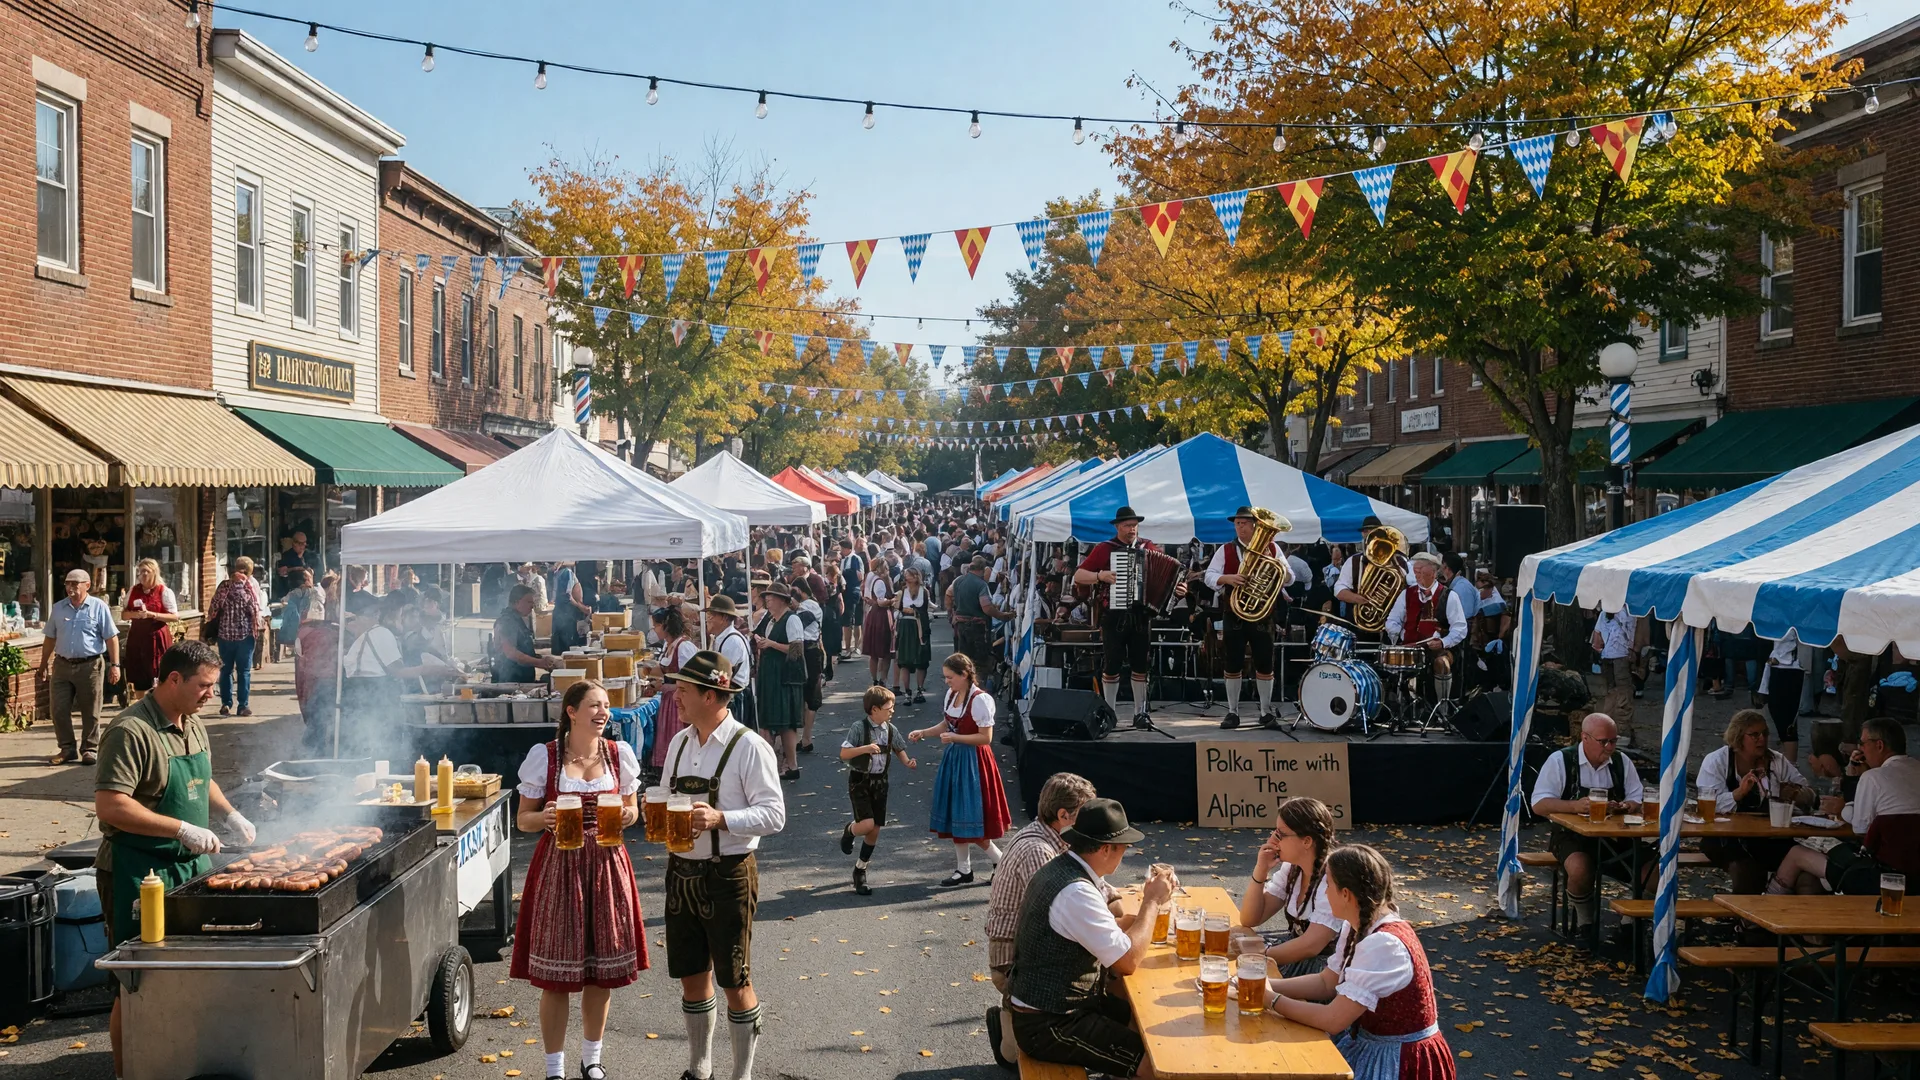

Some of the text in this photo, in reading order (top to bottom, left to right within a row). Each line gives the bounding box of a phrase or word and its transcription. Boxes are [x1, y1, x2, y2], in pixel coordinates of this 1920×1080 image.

[1206, 748, 1340, 772] Polka Time with
[1254, 775, 1288, 793] The
[1207, 793, 1268, 826] Alpine
